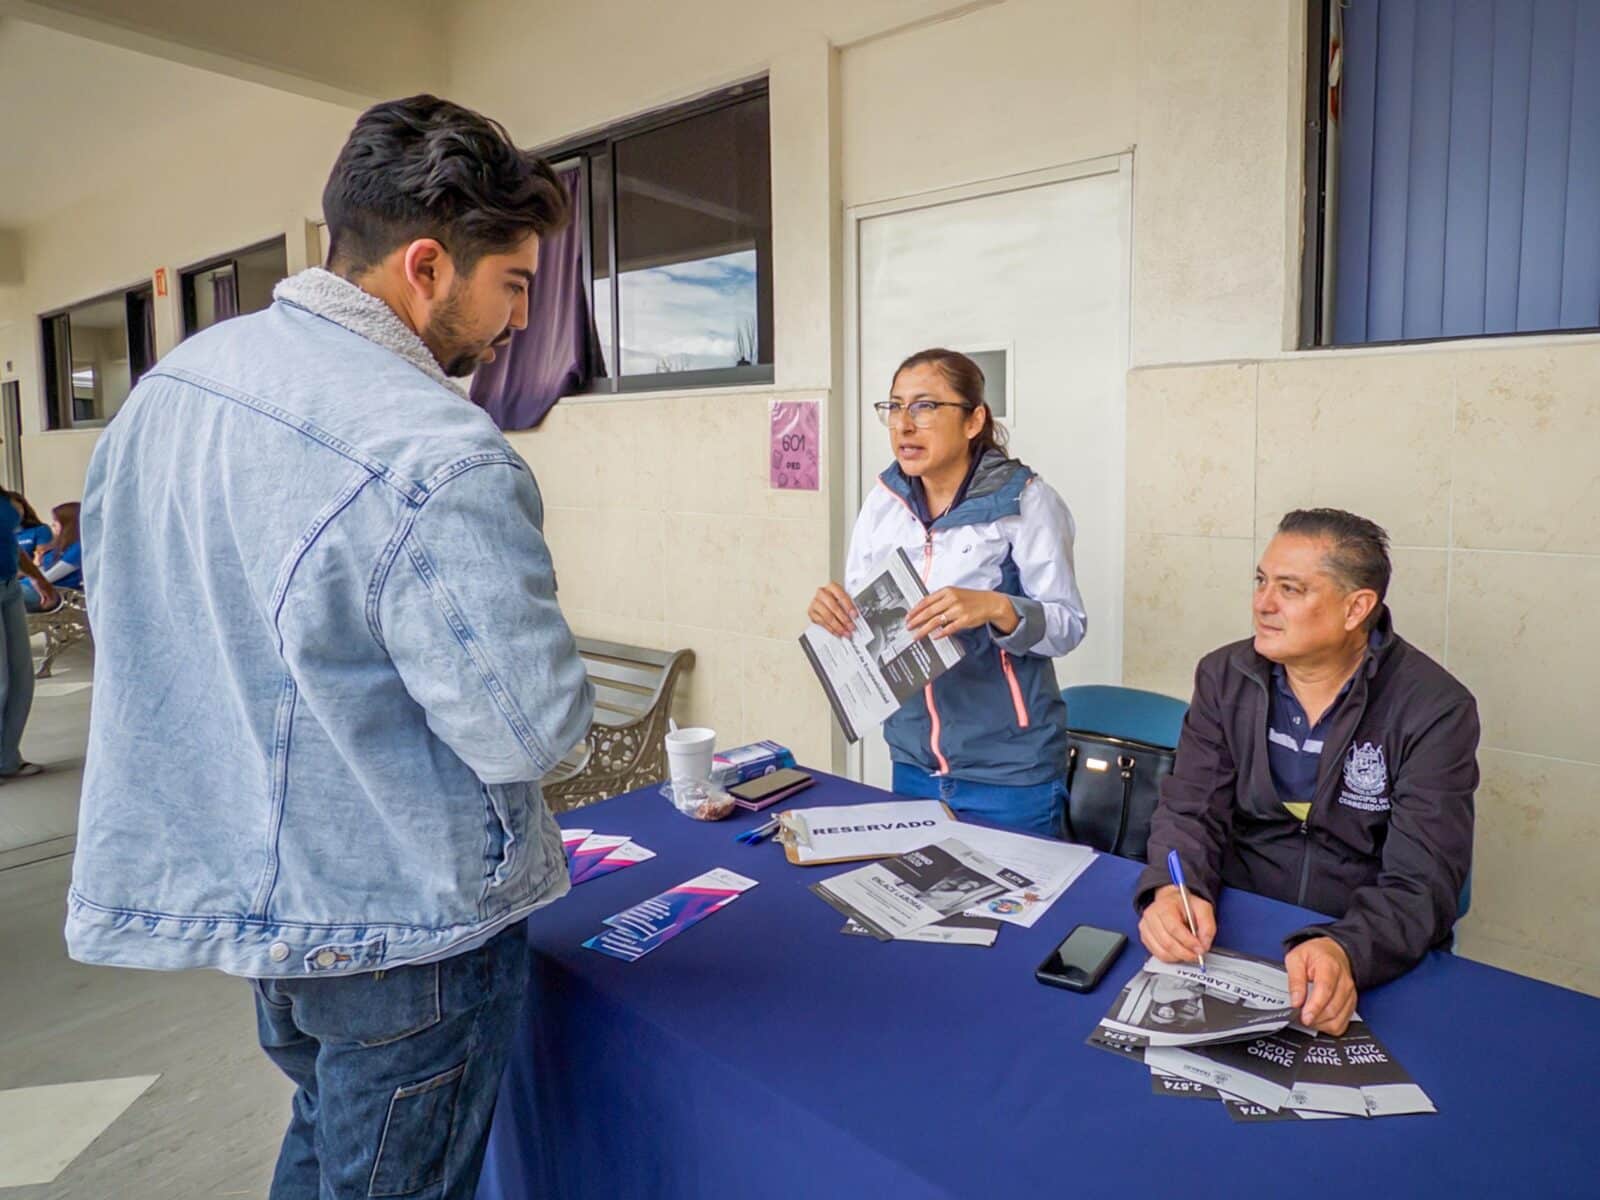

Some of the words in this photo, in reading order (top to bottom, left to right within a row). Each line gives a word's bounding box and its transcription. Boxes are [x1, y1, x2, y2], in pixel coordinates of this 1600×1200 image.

[782, 434, 805, 452] 601
[812, 819, 937, 836] RESERVADO
[1176, 969, 1231, 992] LABORAL
[1232, 985, 1286, 1006] ENLACE
[1248, 1046, 1293, 1068] JUNIO
[1308, 1046, 1338, 1056] 202
[1303, 1054, 1343, 1066] JUNI
[1239, 1105, 1267, 1116] 574
